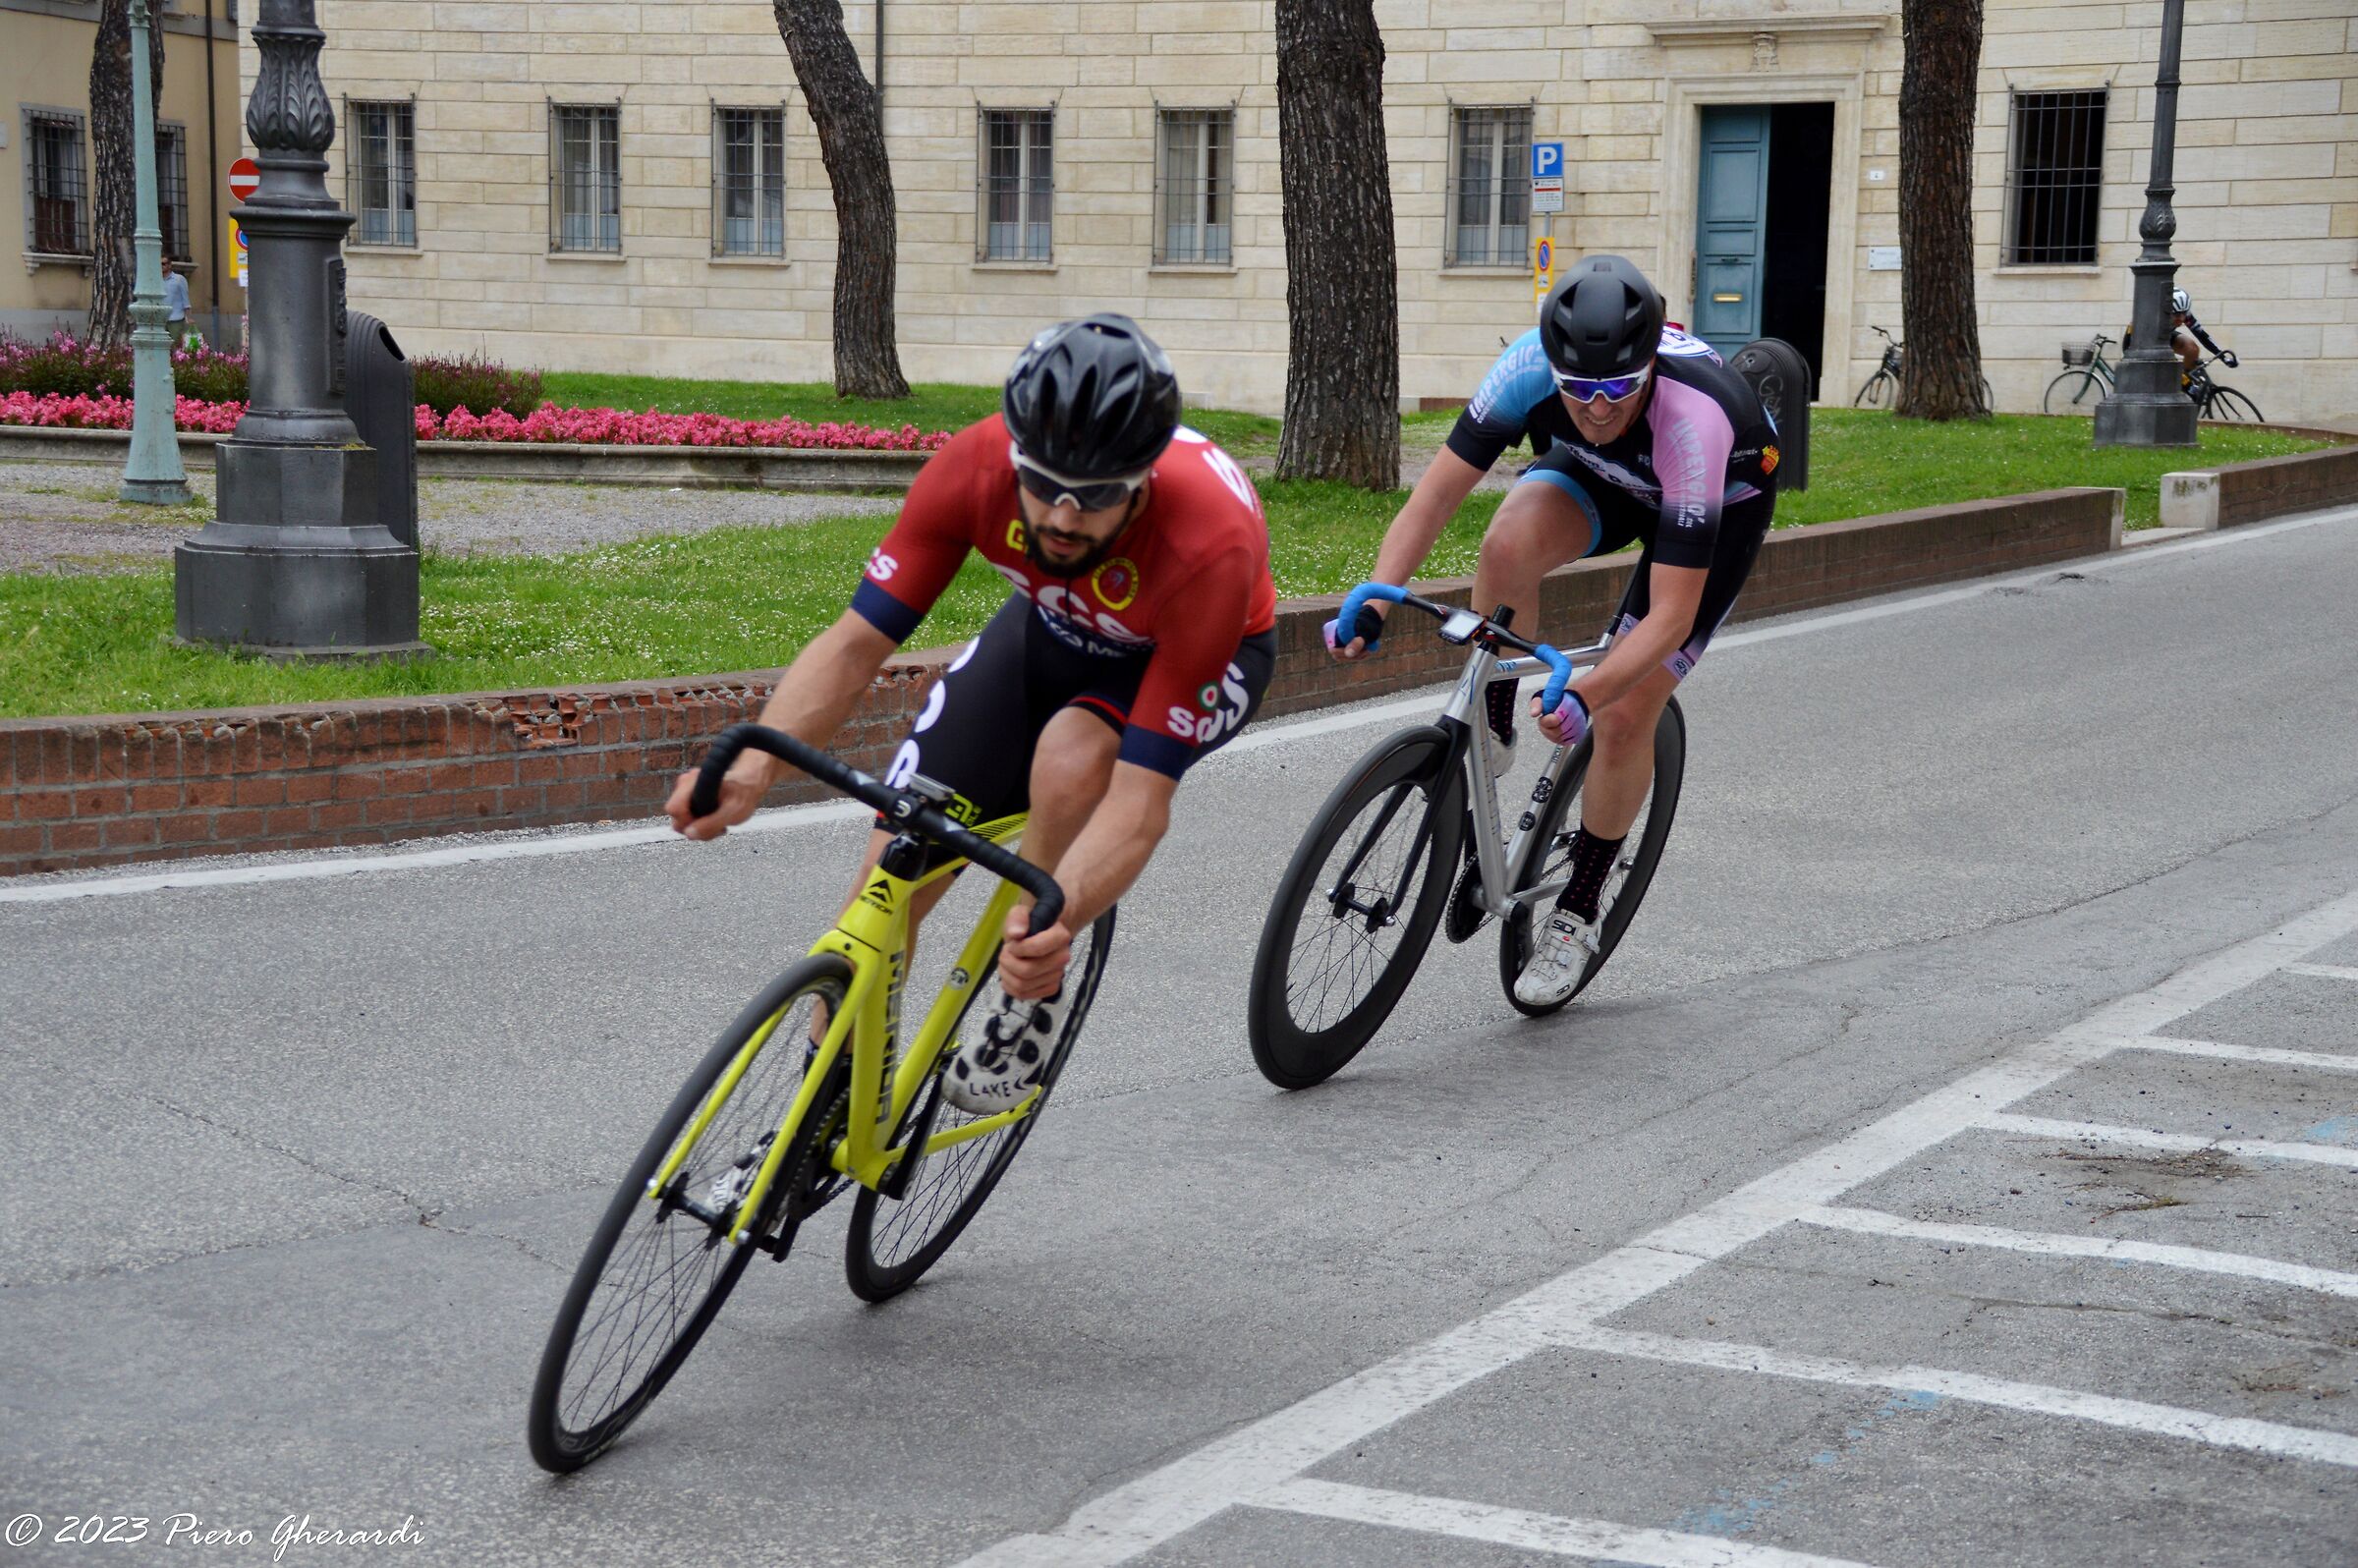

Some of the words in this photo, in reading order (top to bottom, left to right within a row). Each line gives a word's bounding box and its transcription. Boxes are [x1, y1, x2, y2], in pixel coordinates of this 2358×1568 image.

[1538, 146, 1557, 174] P
[874, 949, 905, 1125] MERIDA
[970, 1082, 1012, 1098] LAKE
